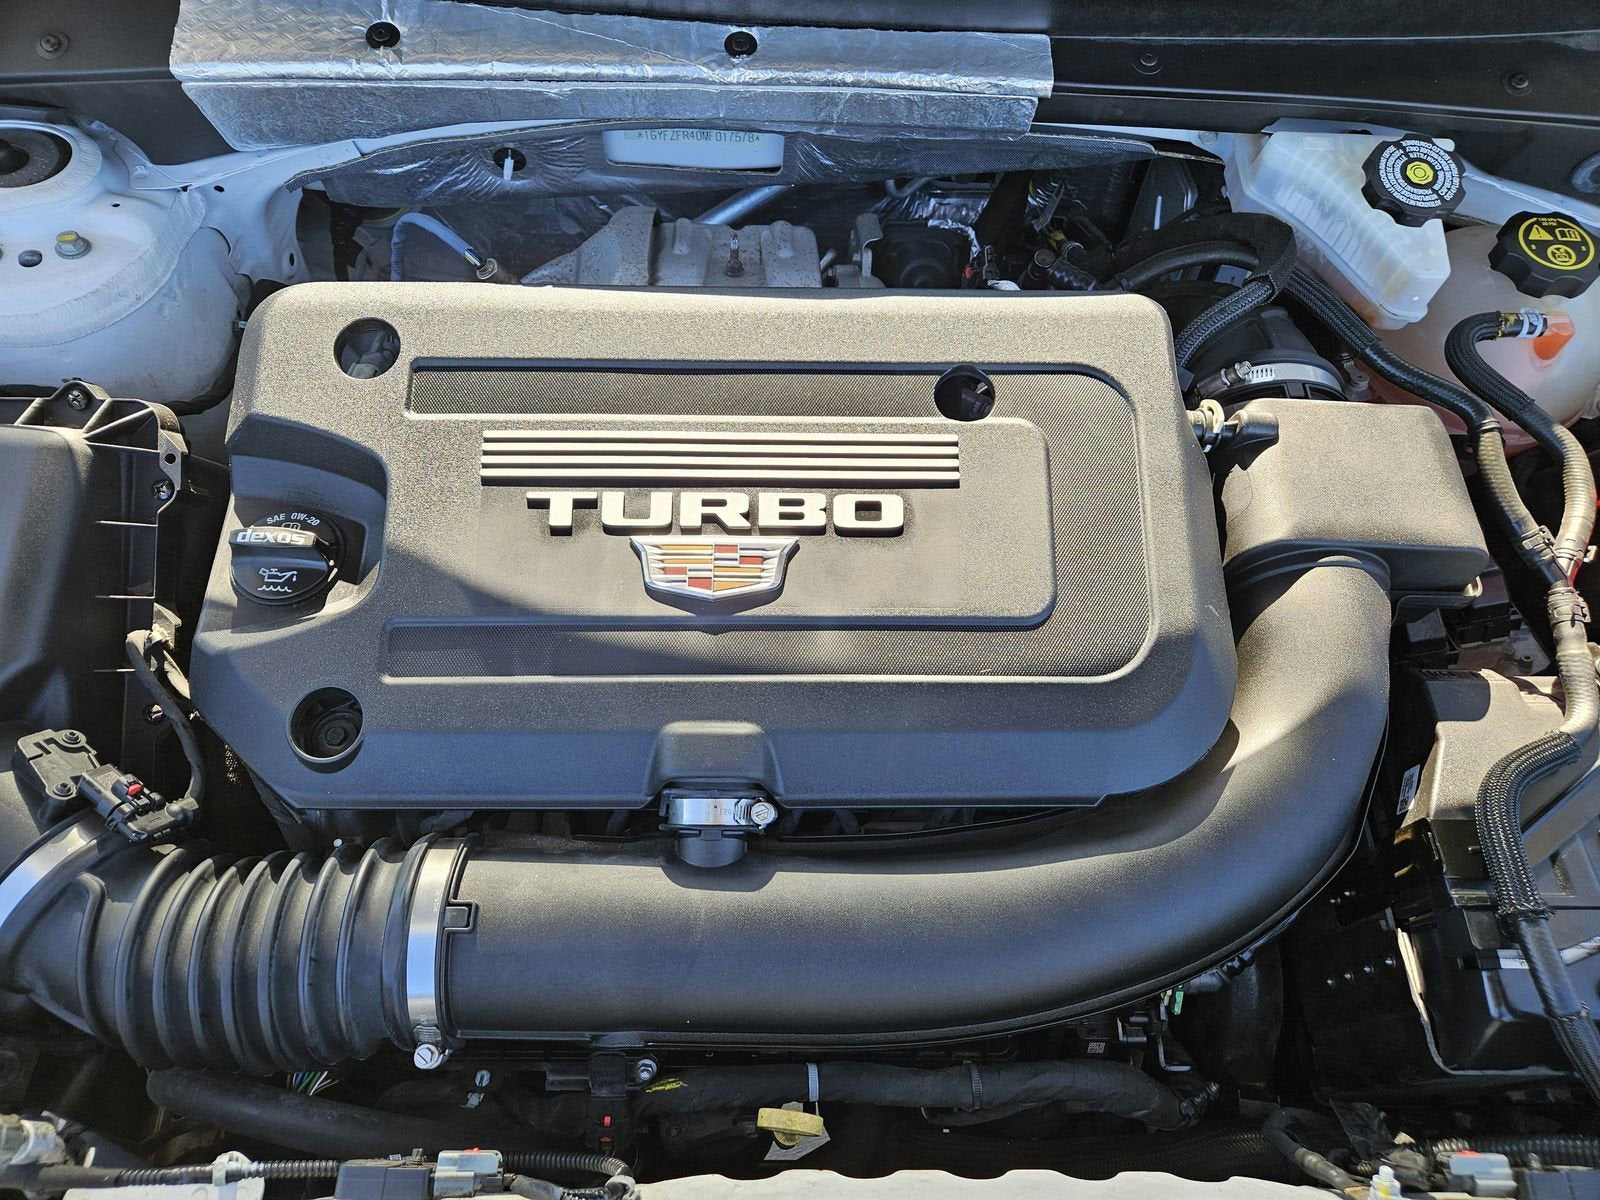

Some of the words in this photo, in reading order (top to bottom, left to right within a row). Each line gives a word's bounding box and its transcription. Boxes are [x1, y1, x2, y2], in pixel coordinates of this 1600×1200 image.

[266, 513, 286, 524] SAE
[290, 512, 320, 526] 0W-20
[526, 491, 904, 537] TURBO
[236, 528, 305, 545] dexos
